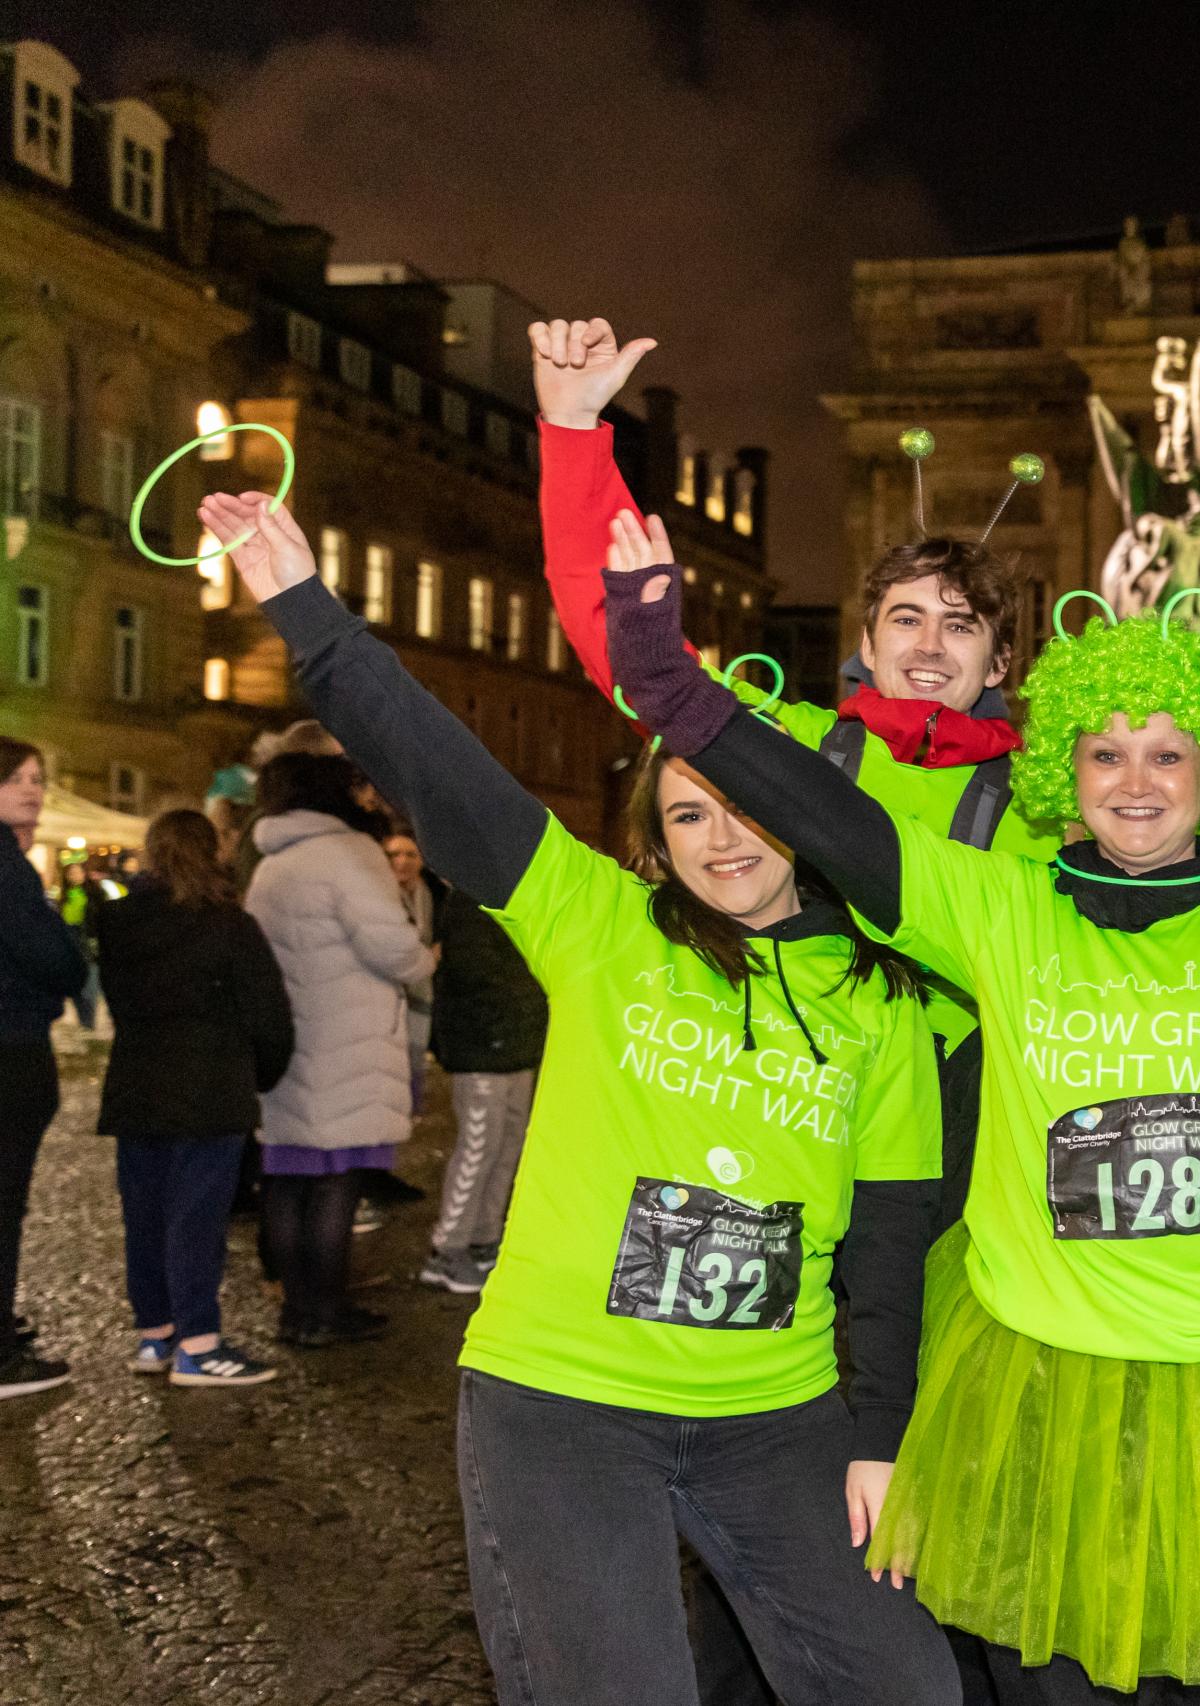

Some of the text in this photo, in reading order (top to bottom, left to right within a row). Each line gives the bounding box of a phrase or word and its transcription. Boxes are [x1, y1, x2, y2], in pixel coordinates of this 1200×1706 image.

[1025, 999, 1139, 1046] GLOW
[624, 1003, 745, 1067] GLOW
[1024, 1042, 1155, 1089] NIGHT
[620, 1041, 752, 1111] NIGHT
[1056, 1130, 1122, 1144] The Clatterbridge
[1132, 1121, 1179, 1137] GLOW
[1136, 1135, 1186, 1152] NIGHT
[638, 1207, 703, 1226] The Clatterbridge
[713, 1217, 760, 1236] GLOW
[711, 1232, 789, 1252] NIGHT ALK
[657, 1246, 768, 1323] 132
